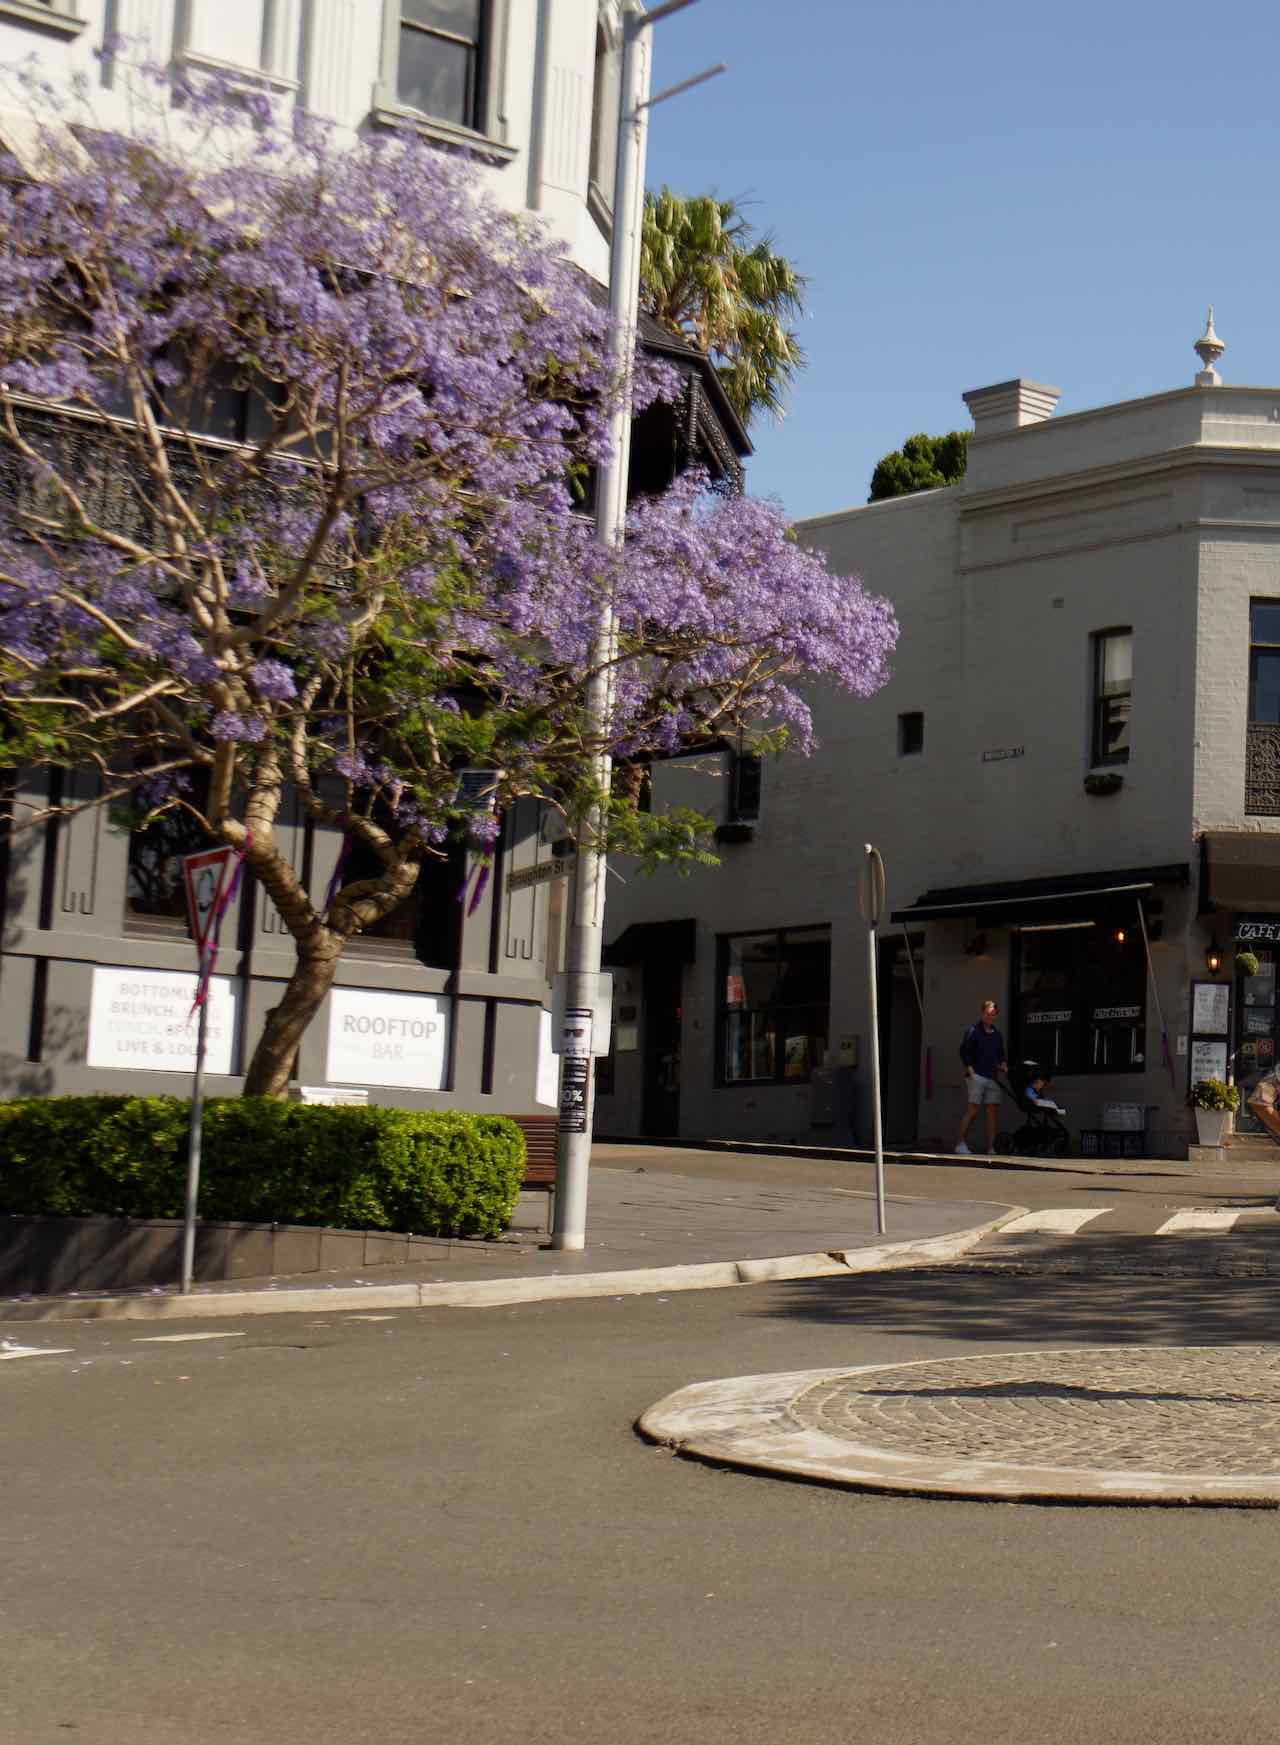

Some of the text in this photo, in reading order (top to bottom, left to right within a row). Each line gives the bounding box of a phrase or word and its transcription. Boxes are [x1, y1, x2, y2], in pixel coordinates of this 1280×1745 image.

[343, 1014, 438, 1040] ROOFTOP
[116, 1040, 149, 1055] LIVE
[372, 1042, 404, 1061] BAR
